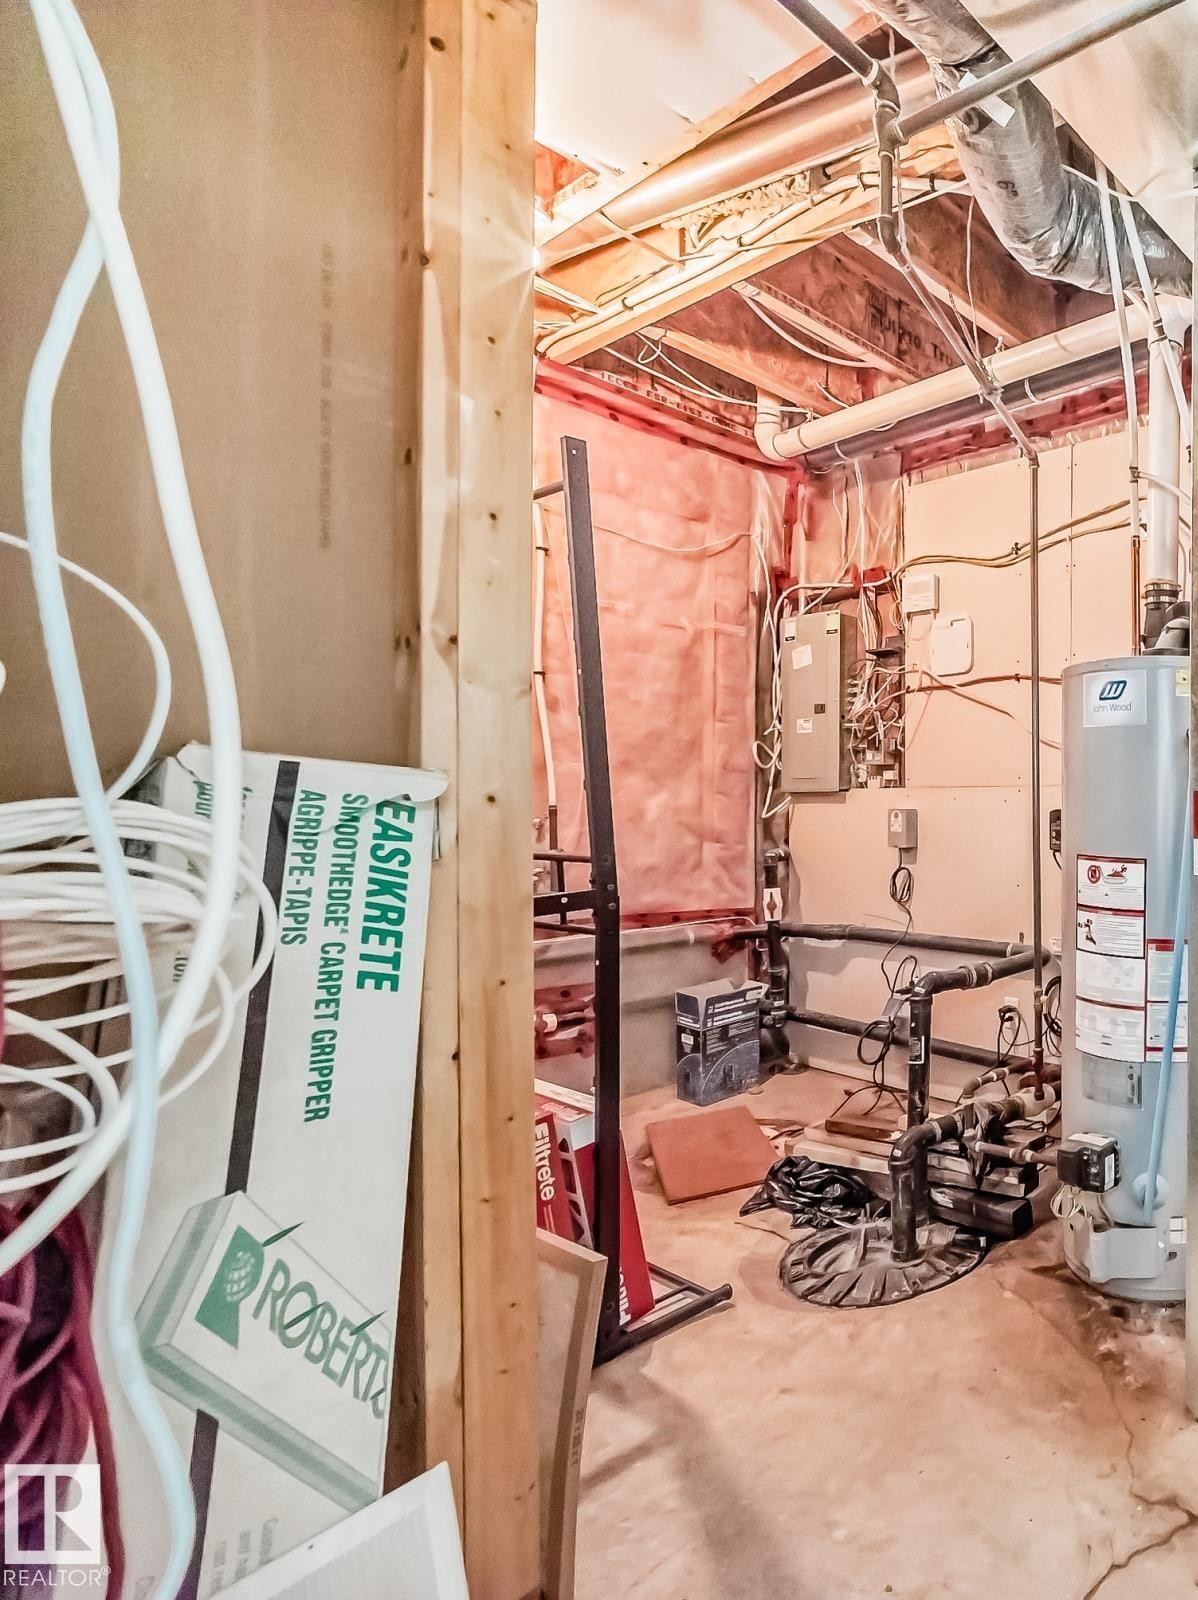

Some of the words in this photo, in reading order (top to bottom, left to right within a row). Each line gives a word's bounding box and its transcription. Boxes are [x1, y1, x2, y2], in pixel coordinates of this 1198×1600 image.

[1109, 702, 1131, 712] Wood
[280, 789, 327, 945] AGRIPPE-TAPIS
[356, 800, 416, 992] EASIKRETE
[313, 942, 346, 1021] CARPET
[303, 1029, 338, 1123] GRIPPER
